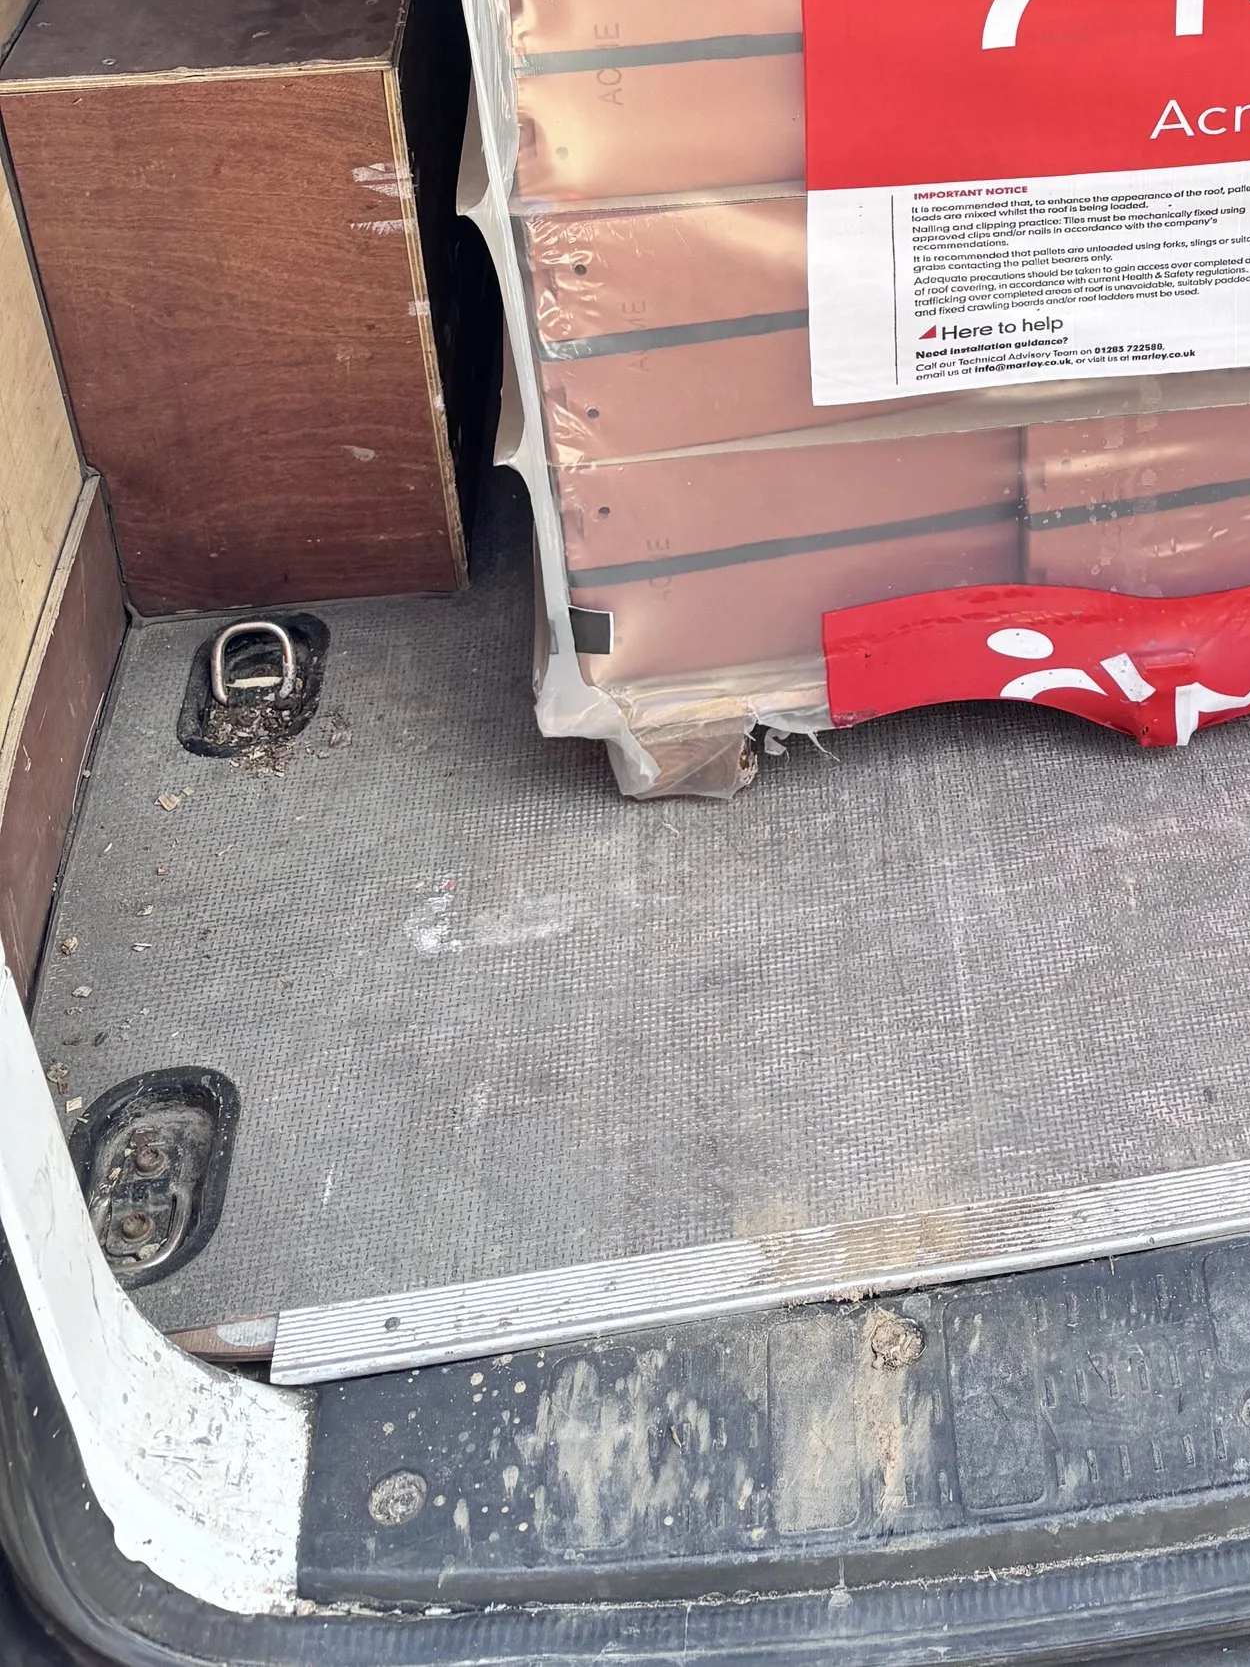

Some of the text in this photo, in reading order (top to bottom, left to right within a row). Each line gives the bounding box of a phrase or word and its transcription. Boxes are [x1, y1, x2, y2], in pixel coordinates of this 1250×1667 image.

[914, 186, 1028, 200] IMPORTANT NOTICE
[931, 200, 1009, 212] recommended
[1110, 192, 1173, 202] appearance
[1174, 189, 1185, 197] of
[911, 214, 942, 222] loads
[964, 210, 997, 218] mixed
[998, 208, 1028, 216] whilst
[1048, 205, 1068, 213] roof
[1079, 203, 1109, 212] being
[912, 225, 950, 234] Nailing
[952, 223, 974, 231] and
[976, 221, 1017, 231] clipping
[1087, 214, 1111, 223] must
[1194, 208, 1219, 216] fixed
[1220, 206, 1246, 214] using
[912, 232, 966, 243] approved
[967, 231, 991, 240] clips
[1124, 221, 1145, 229] with
[1146, 220, 1163, 228] the
[913, 240, 1009, 251] recommendations.
[913, 263, 946, 273] grabs
[948, 261, 1002, 269] contacting
[1021, 258, 1050, 268] pallet
[1091, 254, 1113, 263] only.
[942, 317, 1064, 340] Here to help
[915, 348, 948, 358] Need
[1014, 337, 1069, 350] guidance?
[916, 370, 946, 380] email
[1132, 350, 1196, 361] marley.co.uk
[960, 354, 1006, 366] Technical
[1008, 352, 1052, 360] Advisory
